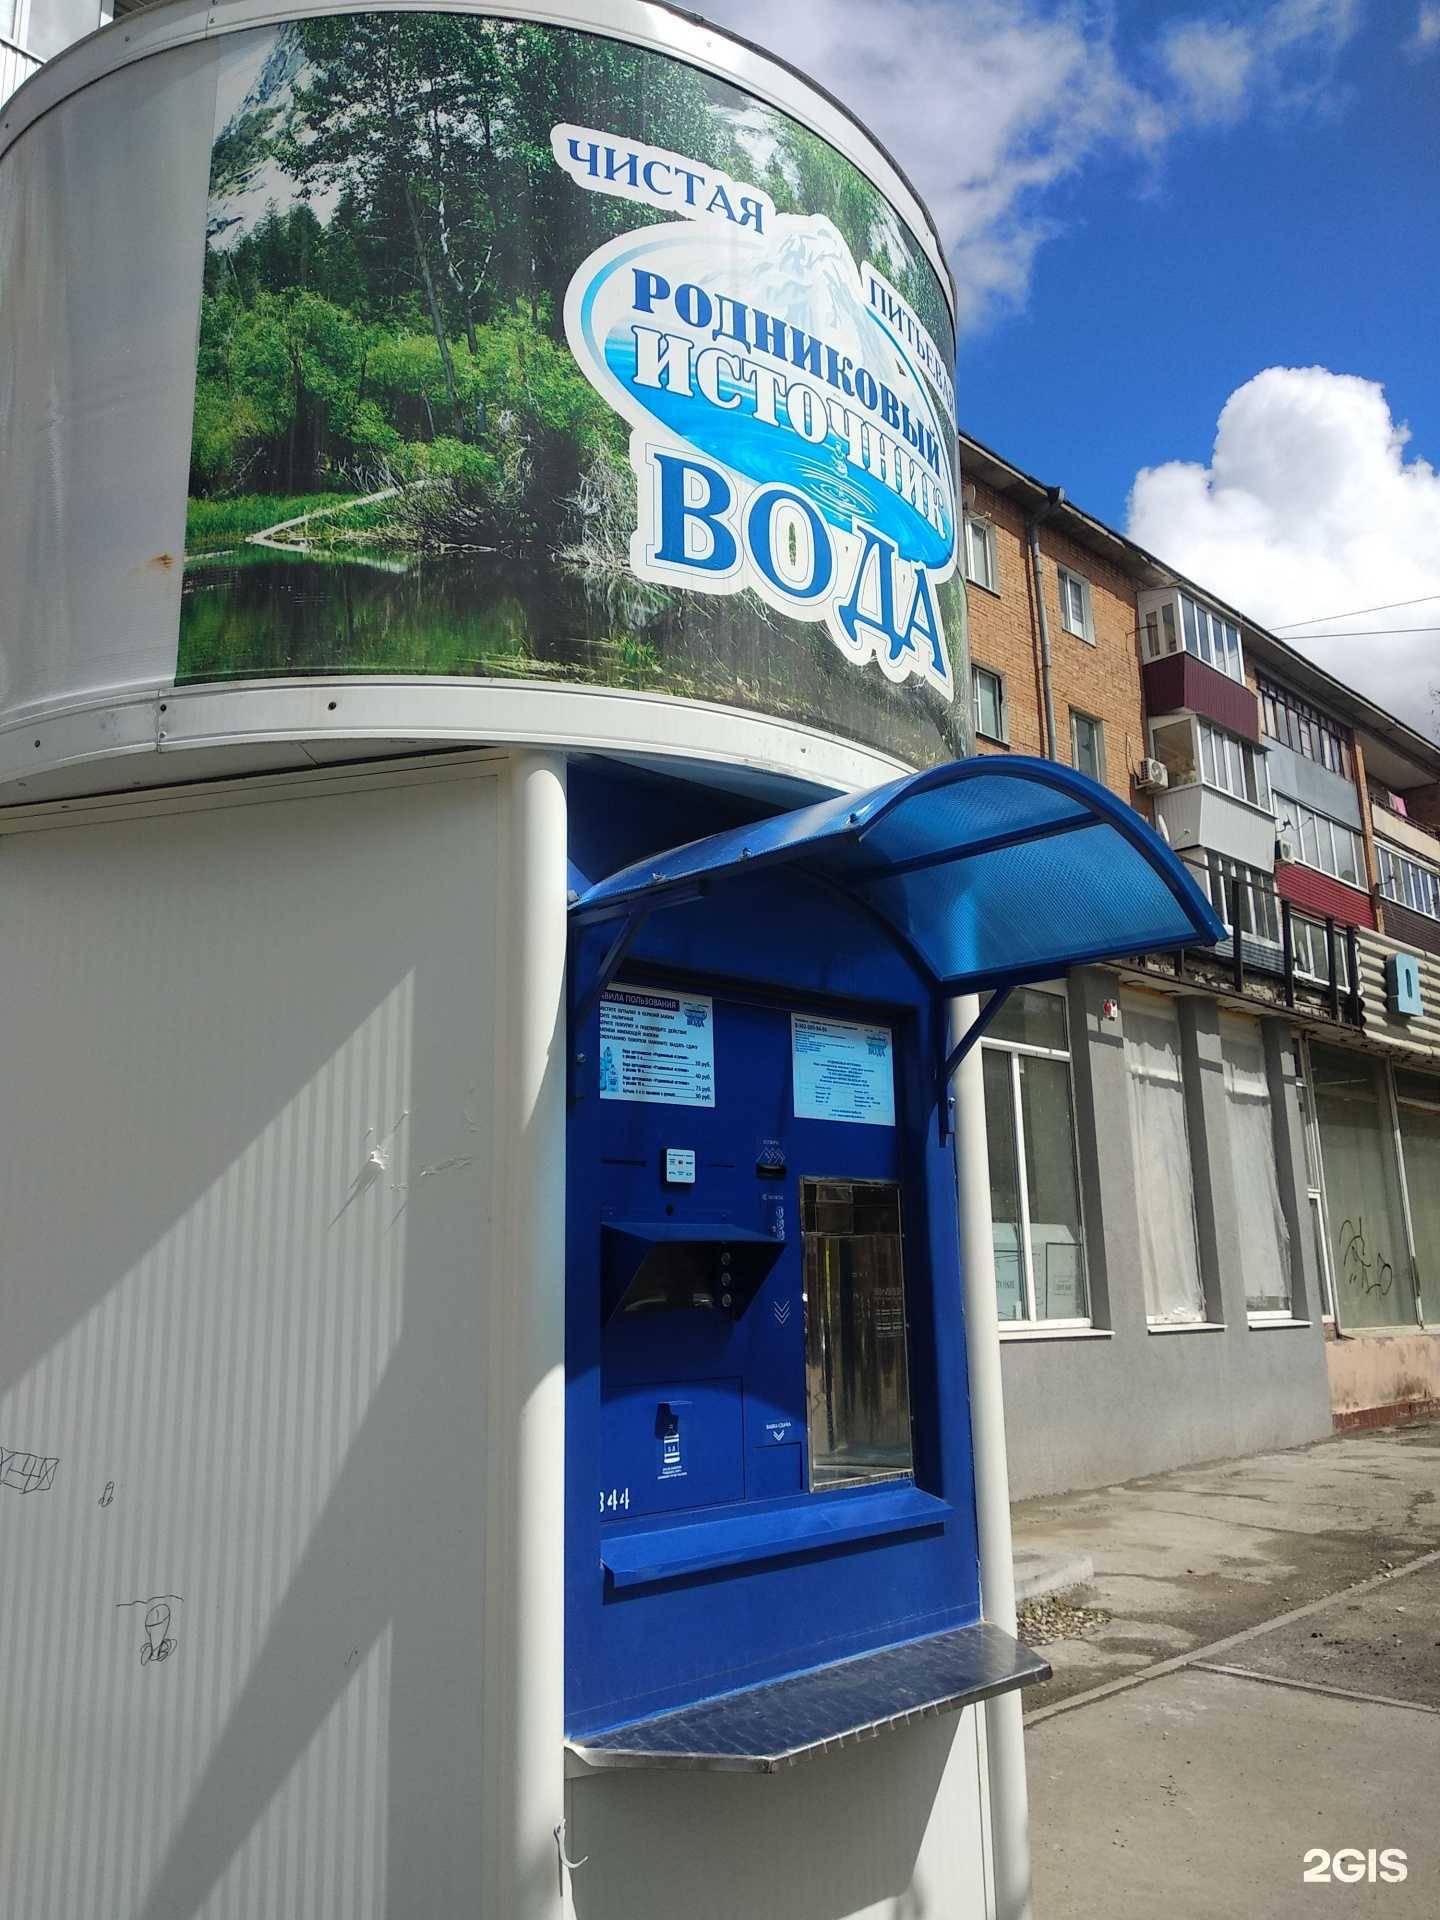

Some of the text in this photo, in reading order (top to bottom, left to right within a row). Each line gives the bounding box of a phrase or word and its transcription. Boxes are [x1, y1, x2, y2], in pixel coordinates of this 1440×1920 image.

[567, 138, 765, 235] ЧИСТАЯ
[631, 267, 942, 480] РОДНИКОВЫЙ
[631, 325, 948, 542] ИСТОЧНИК
[650, 448, 947, 677] ВОДА
[601, 991, 624, 1001] ВИЛА
